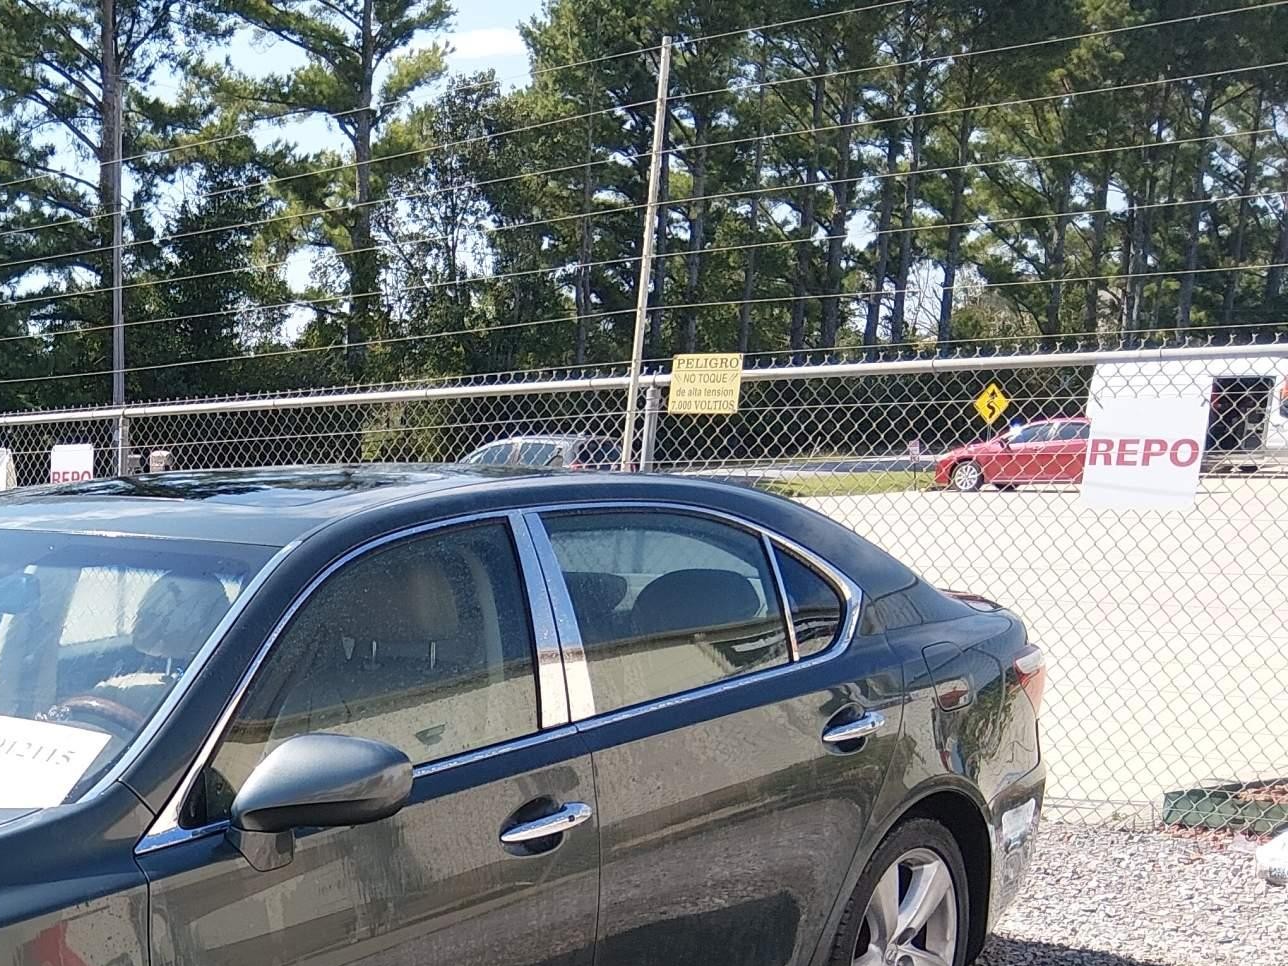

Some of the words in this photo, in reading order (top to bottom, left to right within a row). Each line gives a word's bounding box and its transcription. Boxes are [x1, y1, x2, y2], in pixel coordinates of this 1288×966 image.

[676, 357, 739, 369] PELIGRO
[683, 373, 696, 384] NO
[699, 373, 728, 384] TOQUE
[675, 387, 686, 397] de
[687, 387, 702, 397] alta
[703, 387, 734, 397] tension
[671, 400, 692, 410] 7.000
[694, 400, 735, 410] VOLTIOS
[1088, 438, 1200, 468] REPO
[52, 470, 92, 484] REPO
